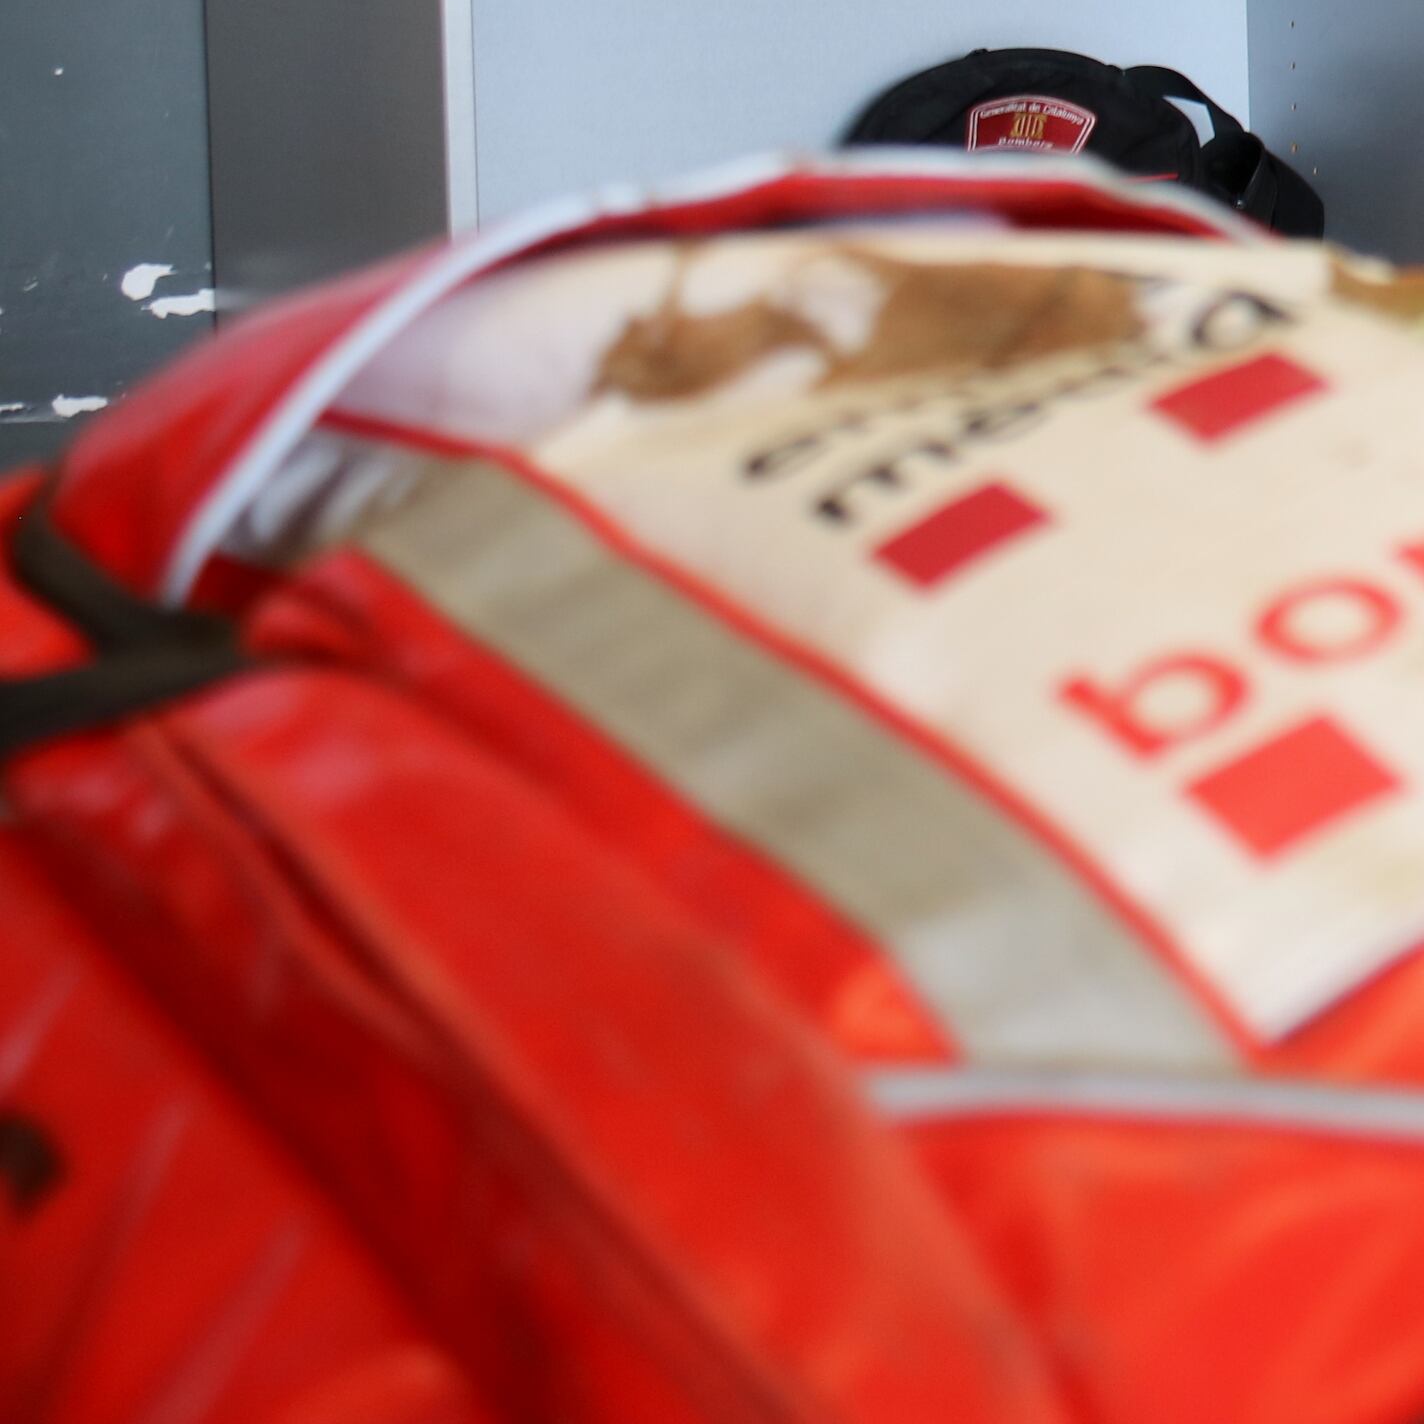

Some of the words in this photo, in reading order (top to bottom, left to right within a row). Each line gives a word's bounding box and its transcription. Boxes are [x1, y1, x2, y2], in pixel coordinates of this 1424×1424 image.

[980, 102, 1026, 119] Generalitat
[1028, 102, 1041, 113] de
[1043, 104, 1085, 126] Catalunya
